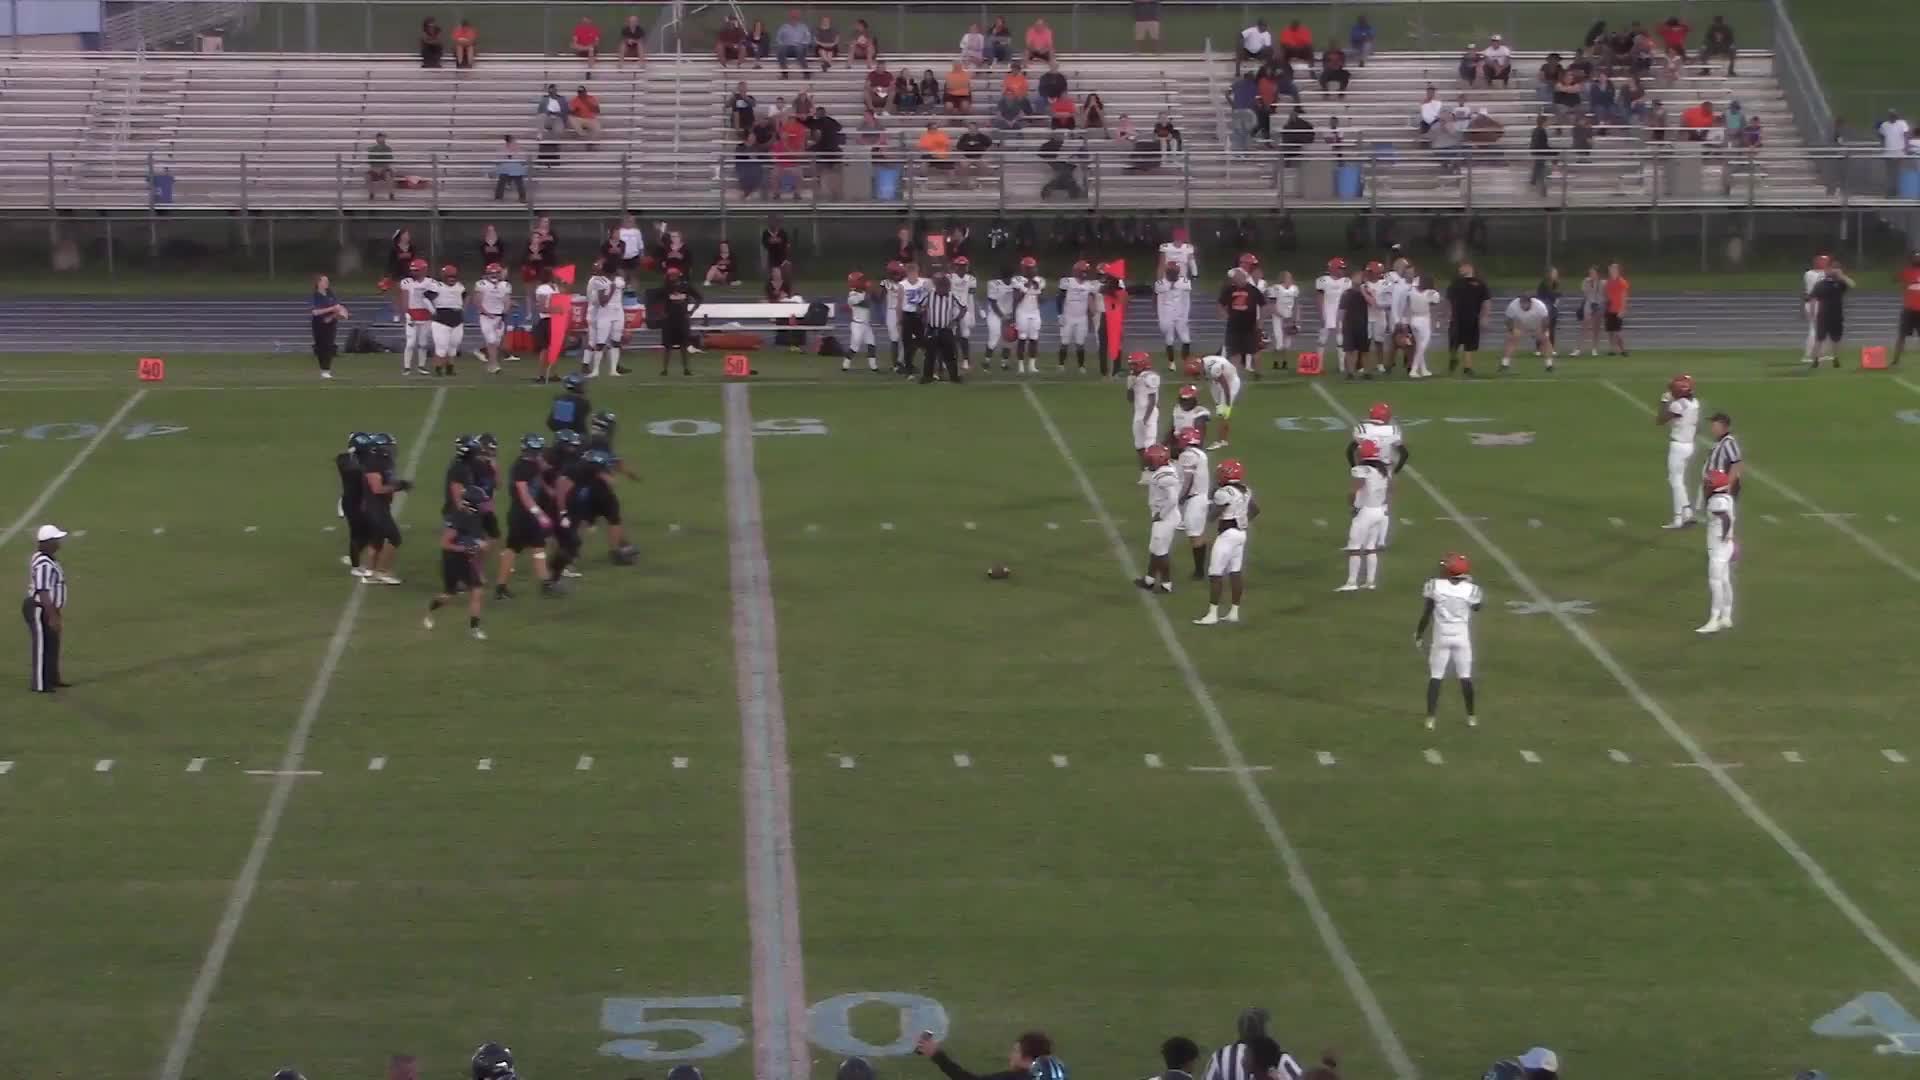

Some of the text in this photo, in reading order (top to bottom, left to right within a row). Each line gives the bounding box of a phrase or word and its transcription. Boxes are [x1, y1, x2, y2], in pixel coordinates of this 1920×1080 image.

[142, 361, 161, 378] 40
[726, 357, 745, 374] 50
[600, 992, 947, 1059] 50
